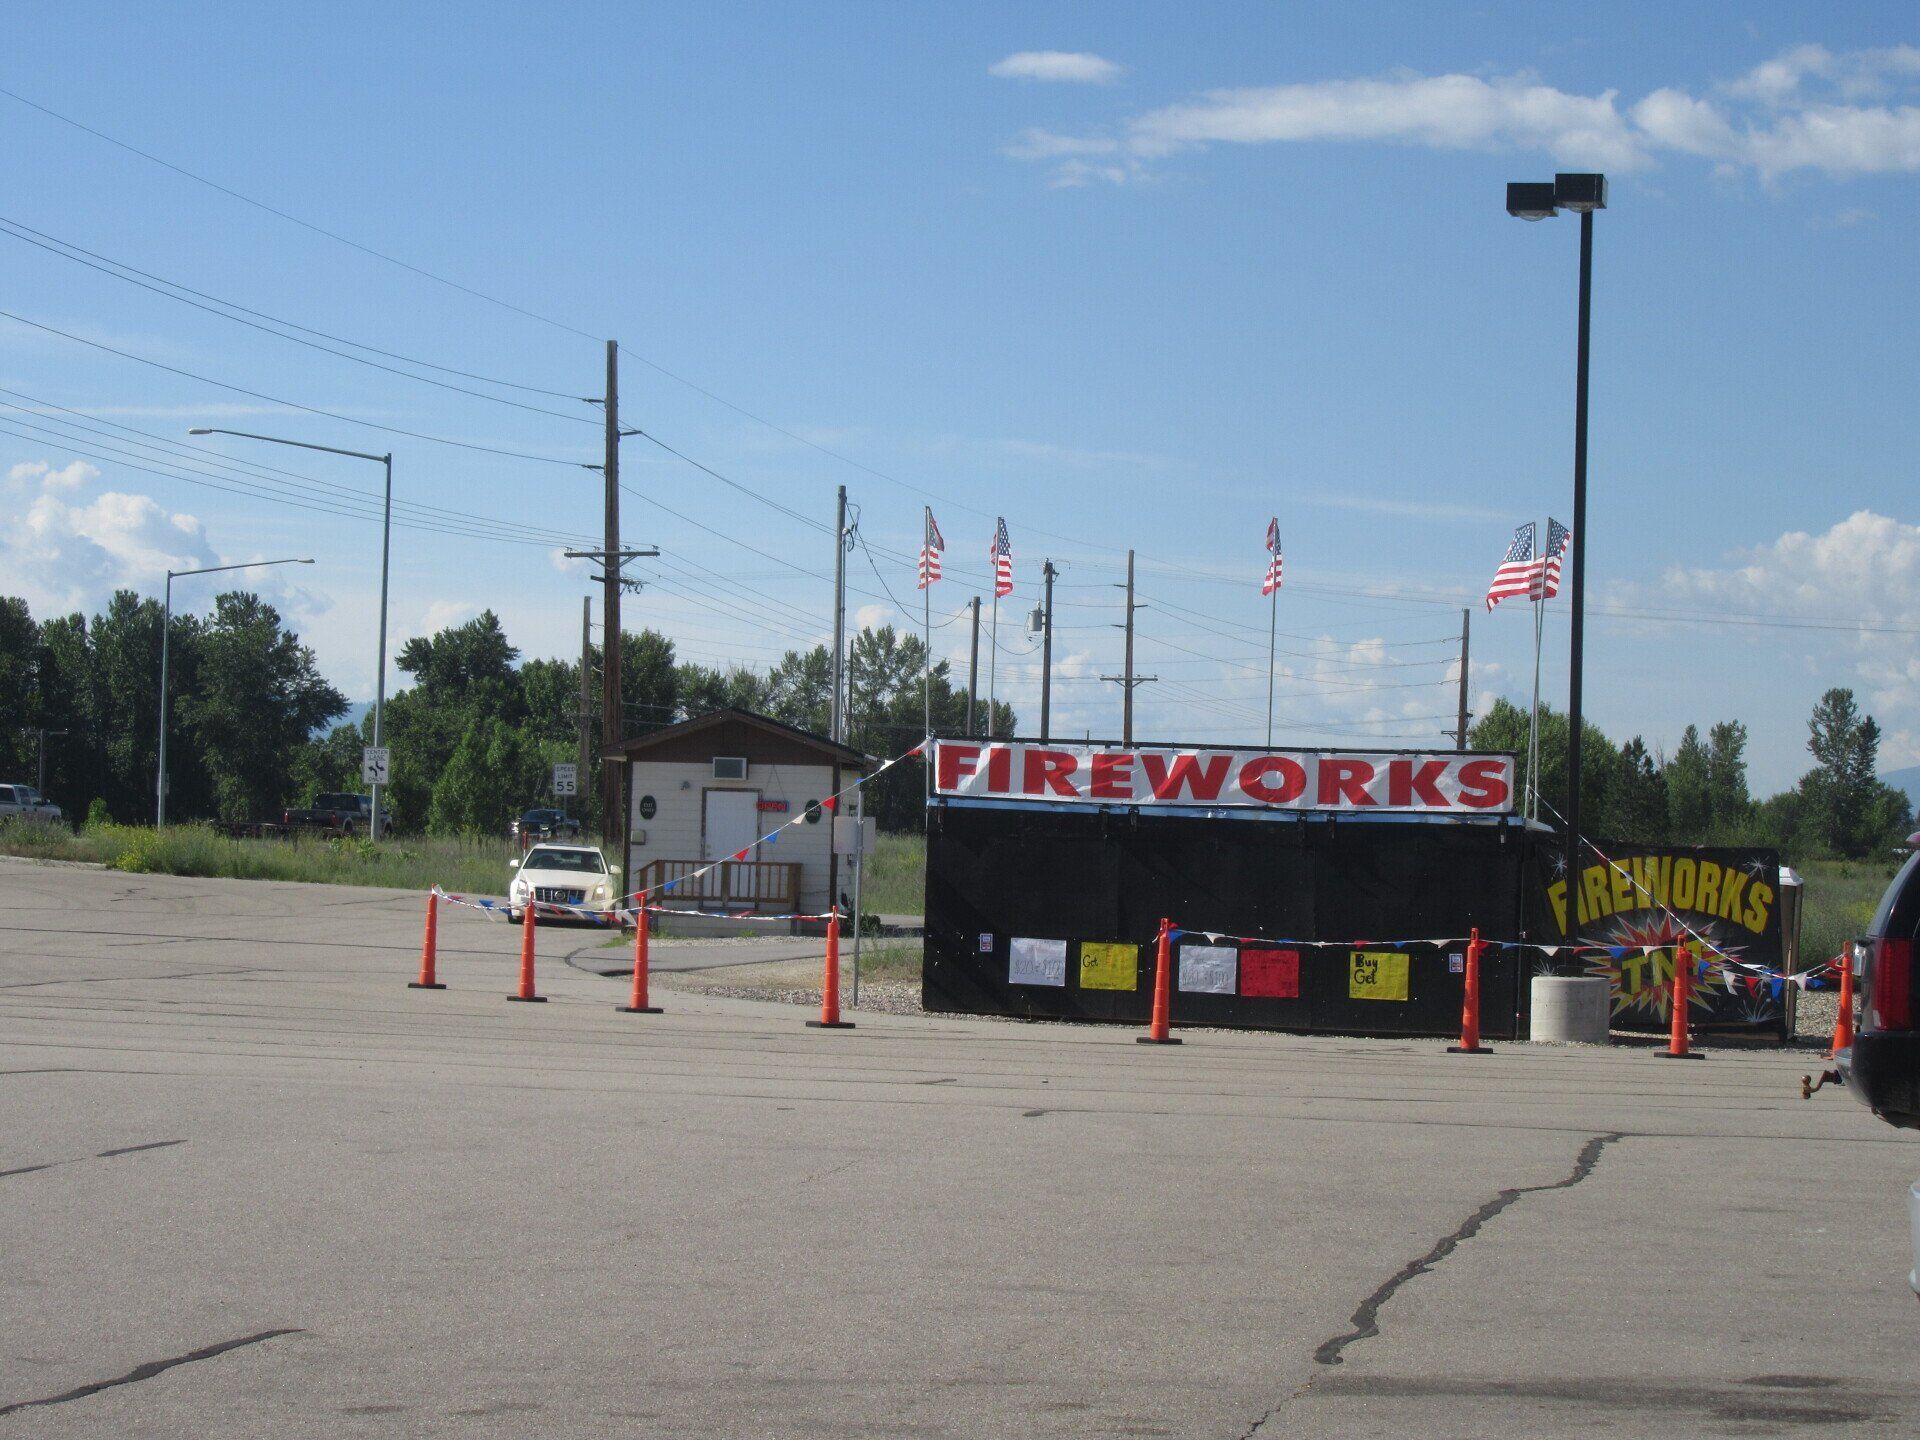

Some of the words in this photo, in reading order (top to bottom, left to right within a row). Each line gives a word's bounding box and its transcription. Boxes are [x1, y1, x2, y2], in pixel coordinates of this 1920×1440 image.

[936, 744, 1509, 808] FIREWORKS
[556, 781, 575, 792] 55
[1083, 954, 1098, 968] Get
[1355, 953, 1378, 972] Buy
[1621, 936, 1712, 996] TNT
[1354, 968, 1377, 985] Get
